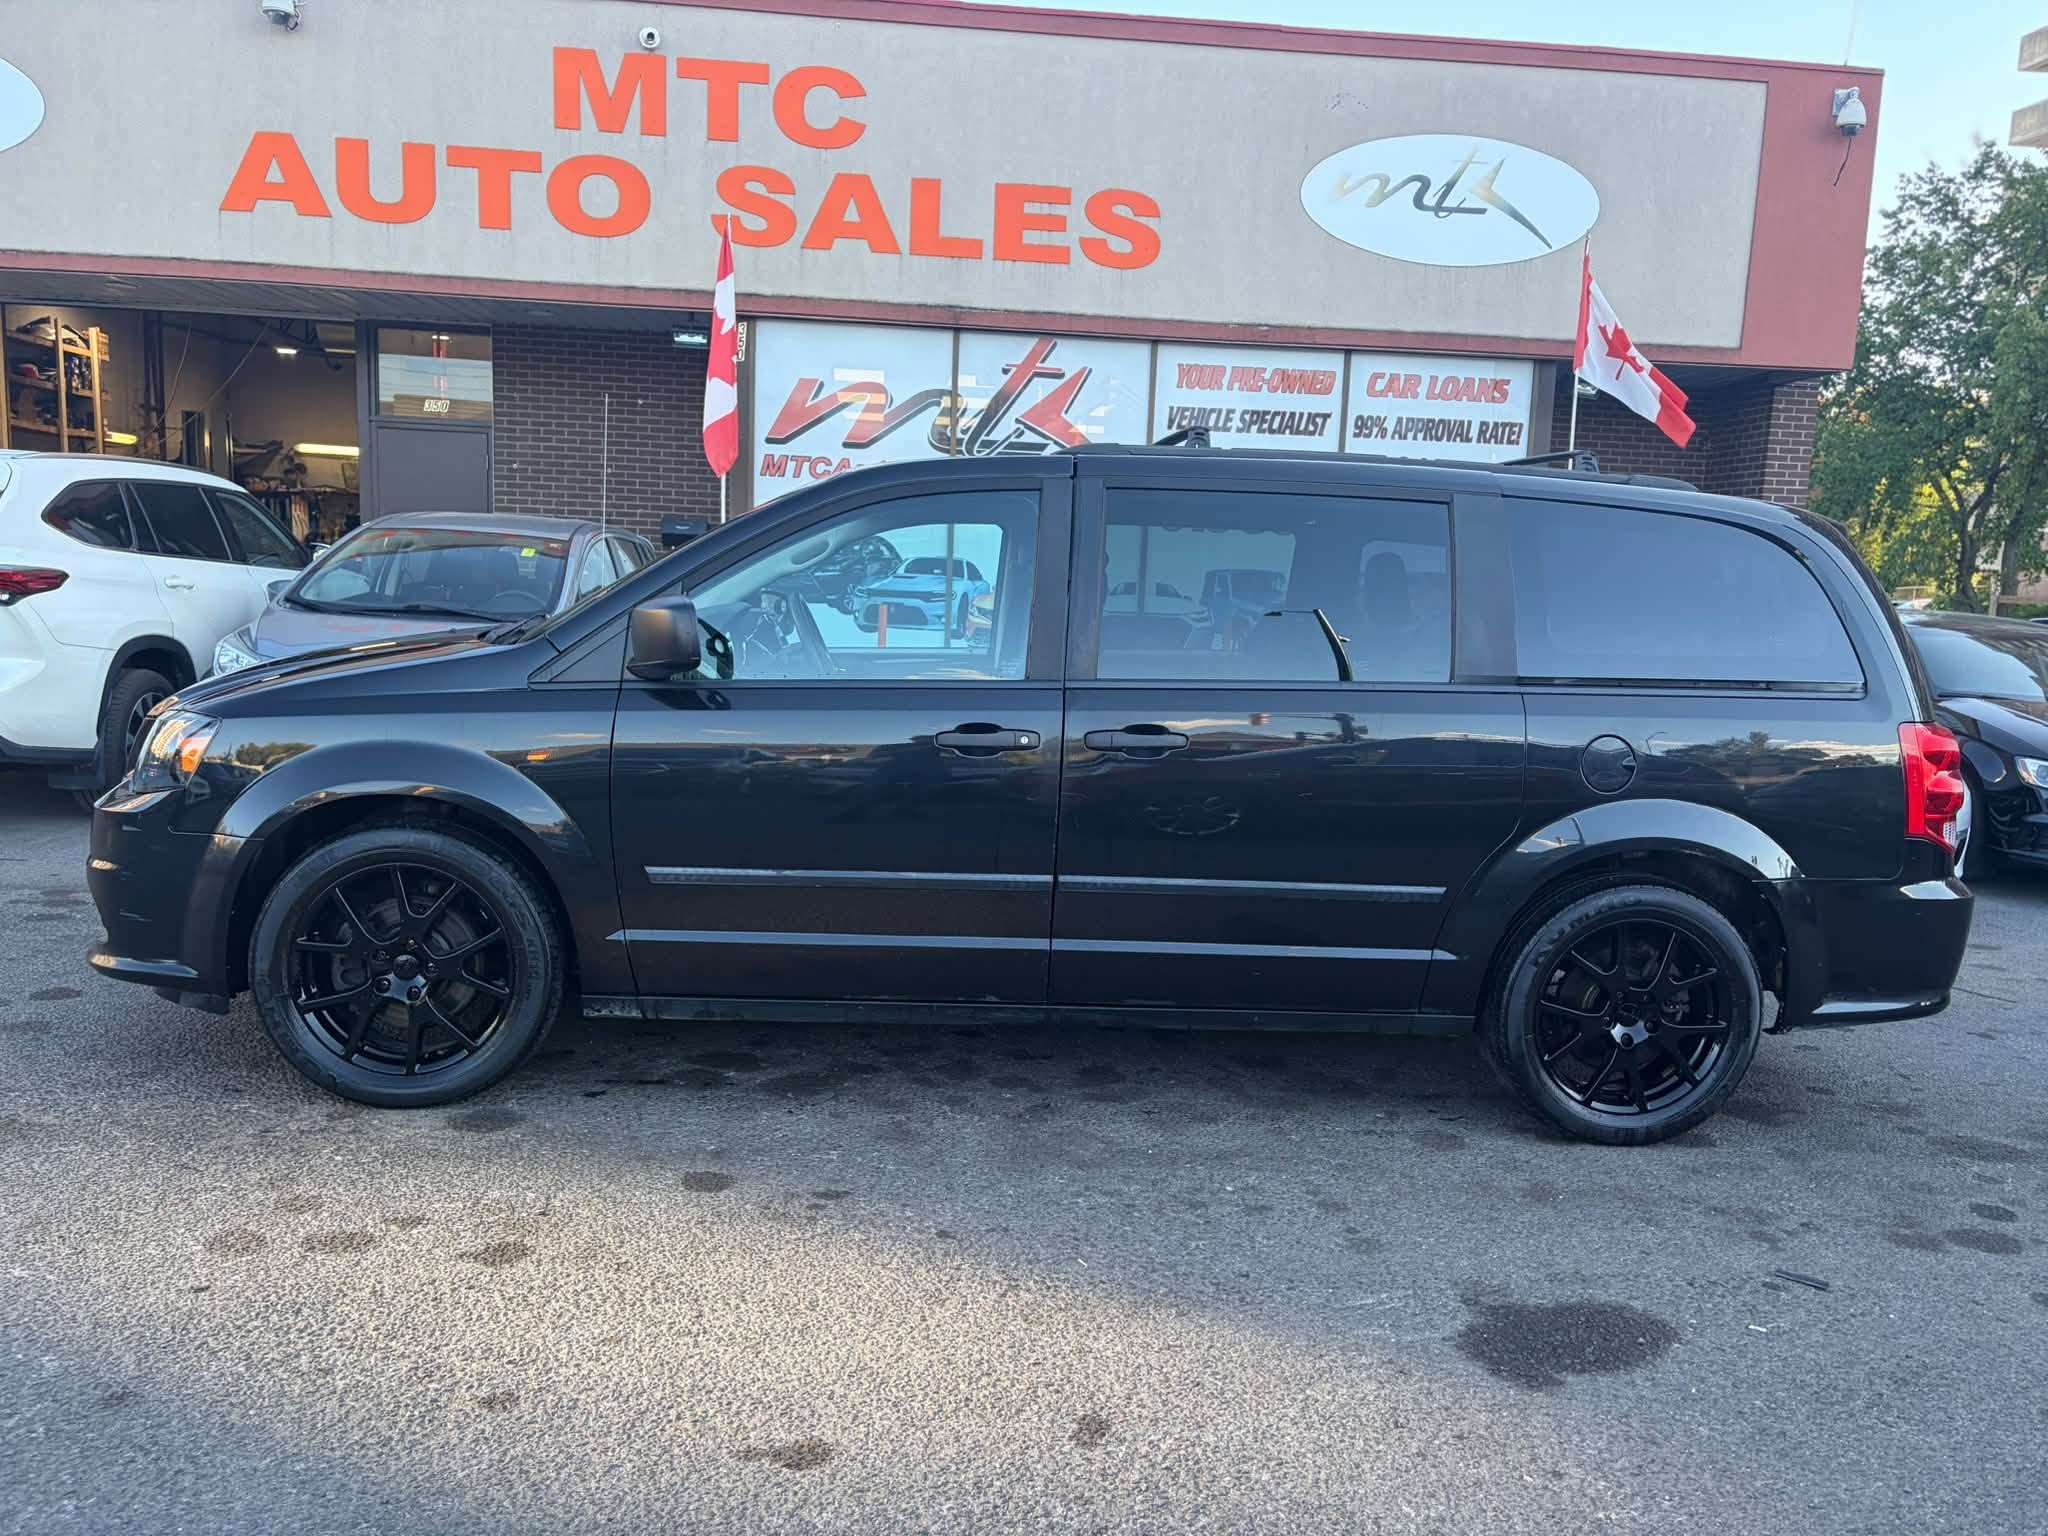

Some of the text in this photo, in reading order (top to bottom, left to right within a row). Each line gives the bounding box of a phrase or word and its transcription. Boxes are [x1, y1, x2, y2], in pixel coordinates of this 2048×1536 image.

[553, 46, 867, 150] MTC
[219, 131, 1161, 271] AUTO SALES
[1176, 363, 1336, 396] YOUR PRE-OWNED
[1366, 372, 1512, 404] CAR LOANS
[1167, 406, 1332, 437] VEHICLE SPECIALIST
[1352, 415, 1523, 445] 99% APPROVAL RATE!
